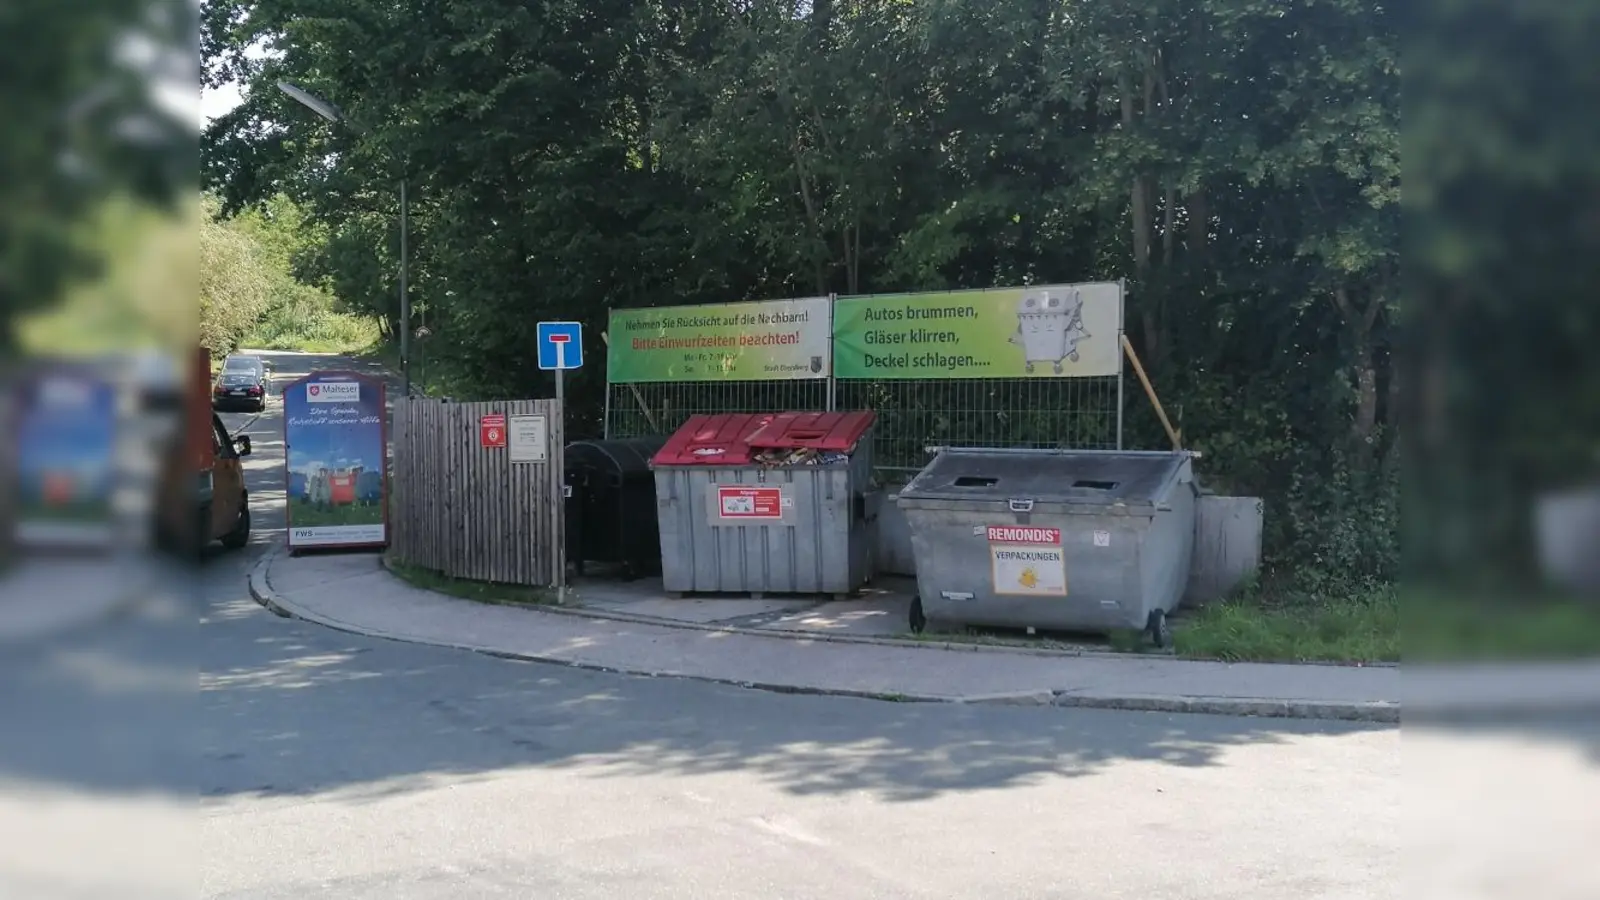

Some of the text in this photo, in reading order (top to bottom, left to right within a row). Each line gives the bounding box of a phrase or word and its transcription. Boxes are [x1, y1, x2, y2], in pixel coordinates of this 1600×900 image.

[625, 309, 809, 331] Nehmen Sie Rücksicht auf die Nachbarn!
[864, 304, 979, 321] Autos brummen,
[632, 330, 800, 350] Bitte Einwurfzeiten beachten!
[864, 329, 960, 345] Gläser klirren,
[864, 352, 991, 370] Deckel schlagen....
[322, 385, 357, 394] Malteser
[994, 551, 1060, 561] VERPACKUNGEN
